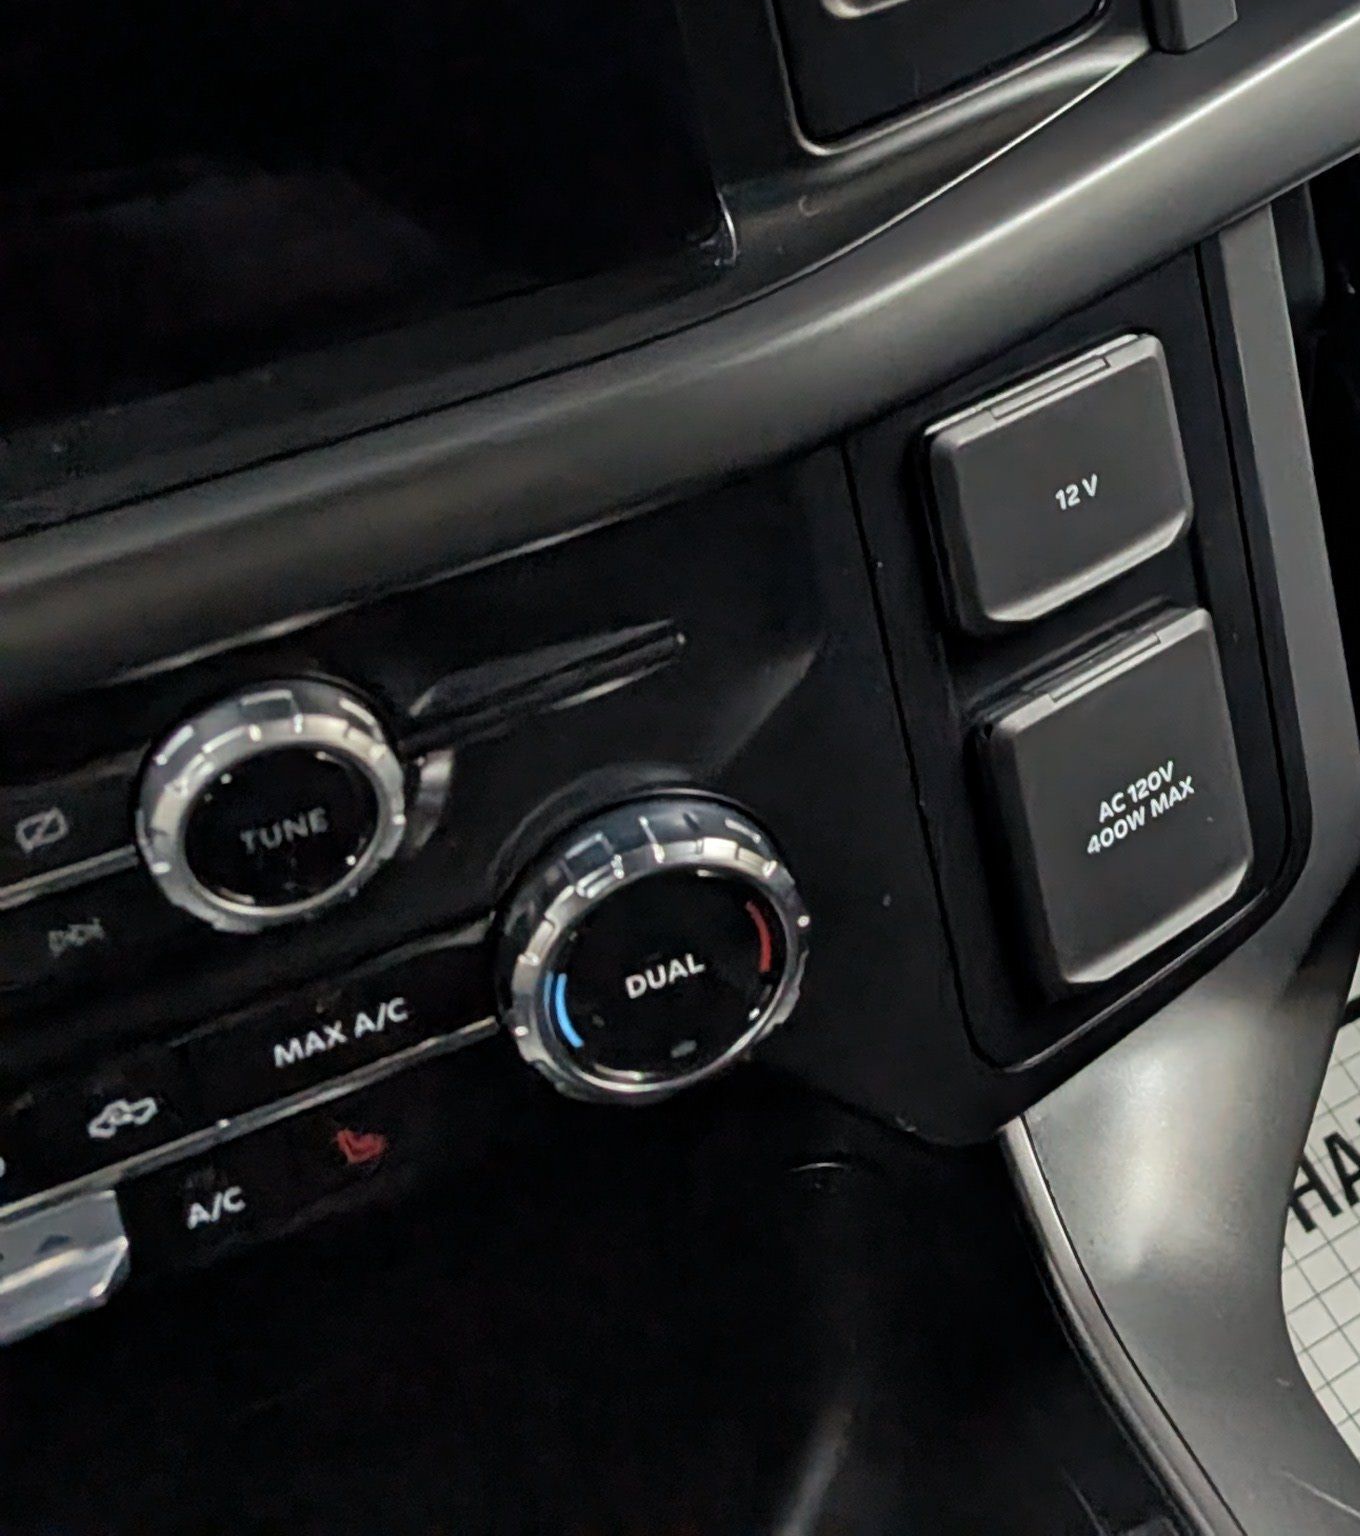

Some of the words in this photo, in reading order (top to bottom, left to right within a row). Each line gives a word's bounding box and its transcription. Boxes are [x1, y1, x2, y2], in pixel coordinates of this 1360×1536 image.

[1087, 805, 1145, 854] 400W
[1150, 775, 1195, 818] MAX
[1099, 791, 1127, 823] AC
[1127, 760, 1174, 803] 120V
[240, 806, 329, 854] TUNE
[624, 952, 707, 999] DUAL
[273, 1020, 348, 1069] MAX
[353, 996, 409, 1038] A/C
[185, 1185, 246, 1230] A/C
